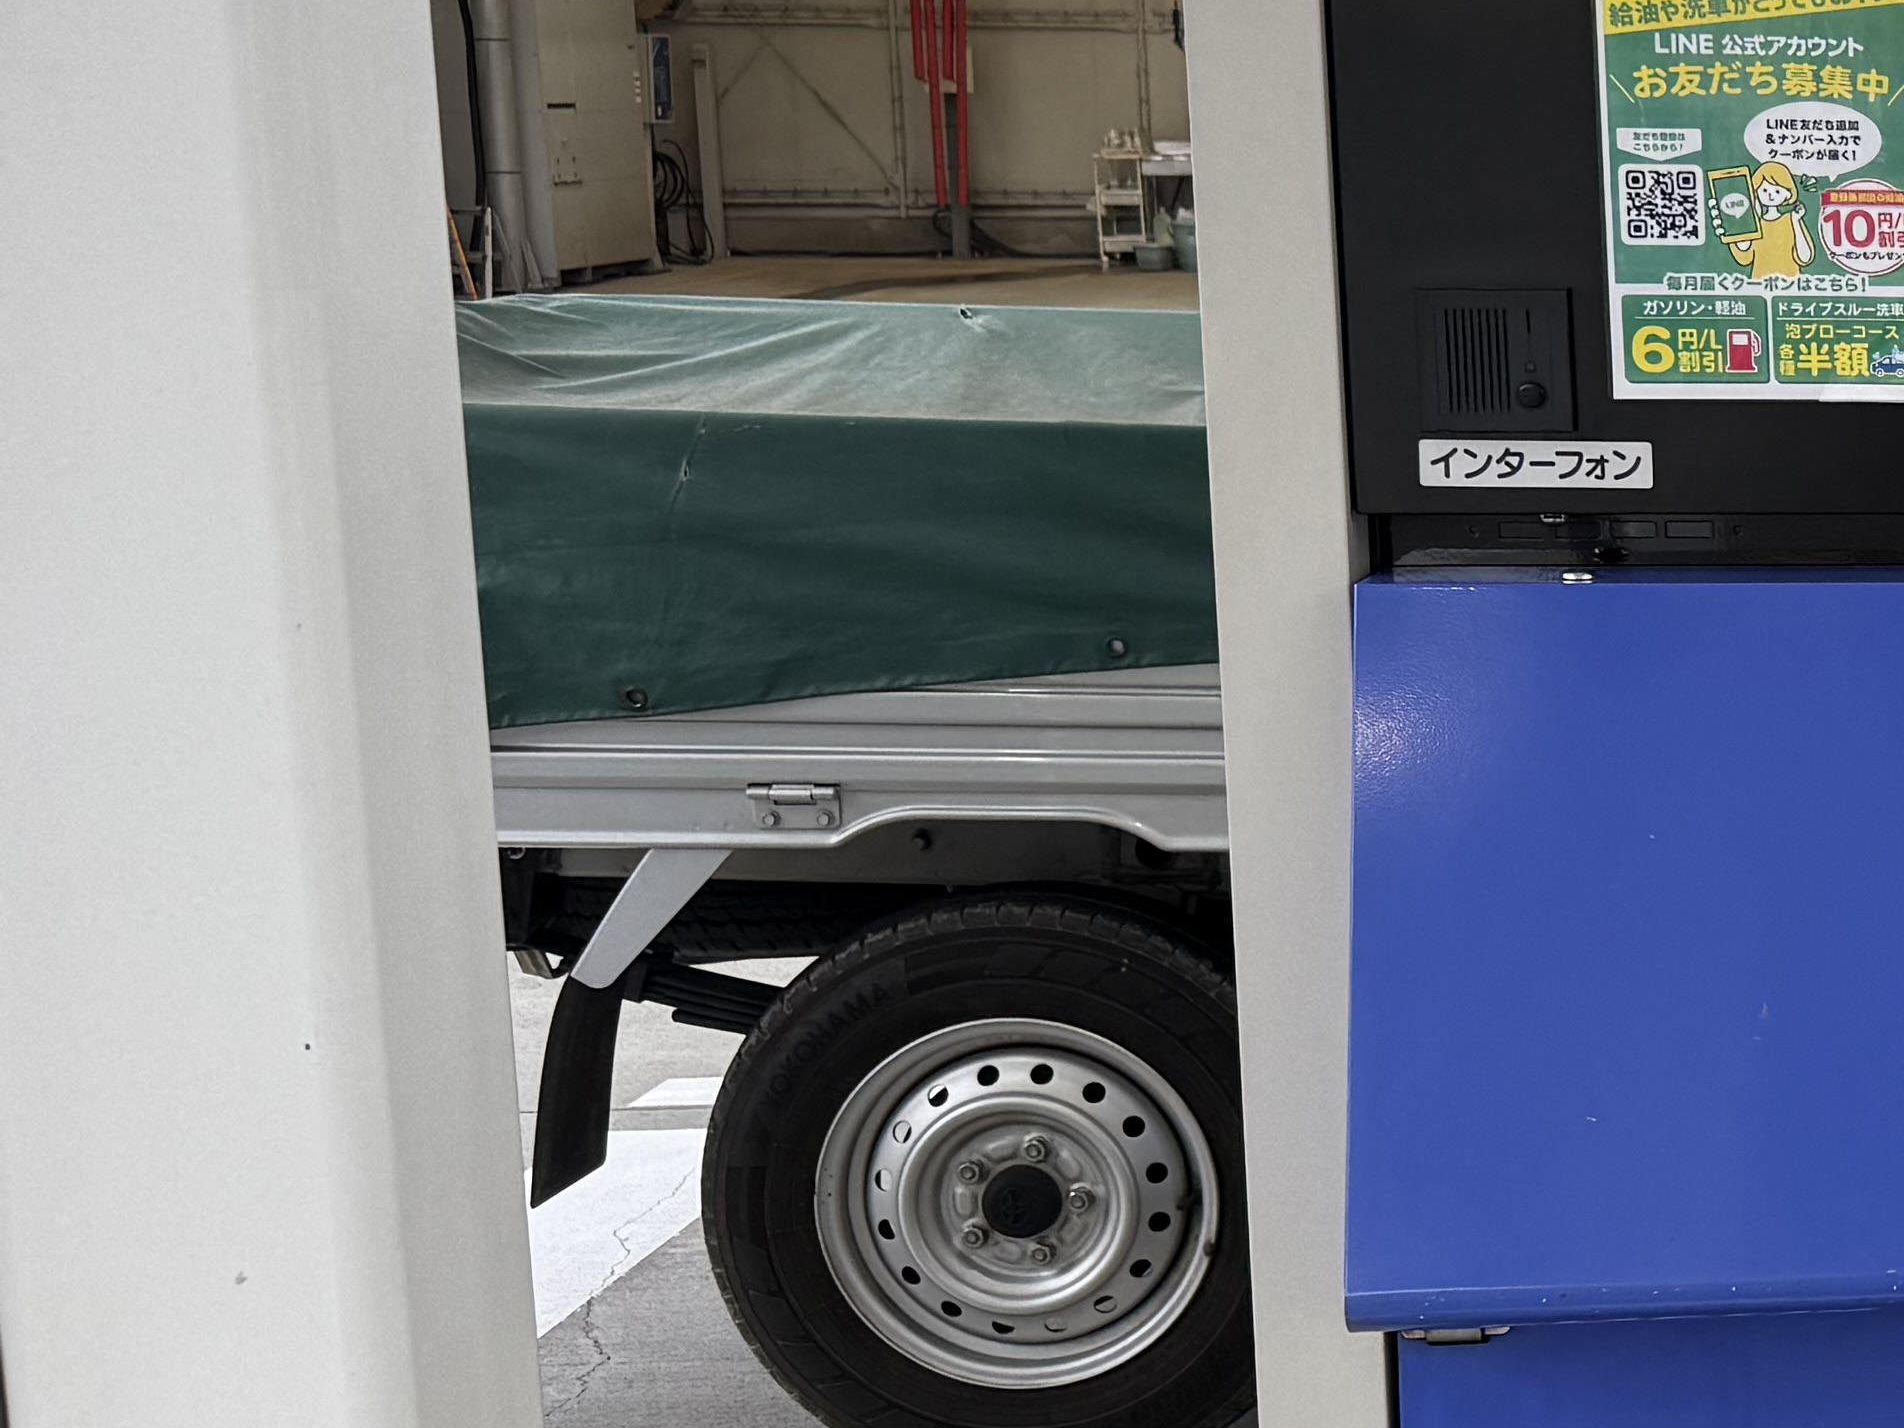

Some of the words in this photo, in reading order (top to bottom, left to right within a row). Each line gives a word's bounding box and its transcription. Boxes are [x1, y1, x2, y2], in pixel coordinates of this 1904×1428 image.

[1654, 32, 1713, 55] LINE
[1722, 35, 1863, 57] 公式アカウント
[1632, 61, 1889, 103] お友だち募集中
[1823, 209, 1875, 248] 10
[1643, 300, 1746, 316] ガソリン・軽油
[1777, 302, 1904, 317] ドライブスルー洗車
[1785, 323, 1899, 339] 泡ブローコース
[1632, 325, 1675, 373] 6
[1678, 351, 1723, 373] 割引
[1797, 342, 1870, 377] 半額
[1430, 447, 1642, 480] インターフォン
[761, 983, 893, 1112] YOKOHAMA
